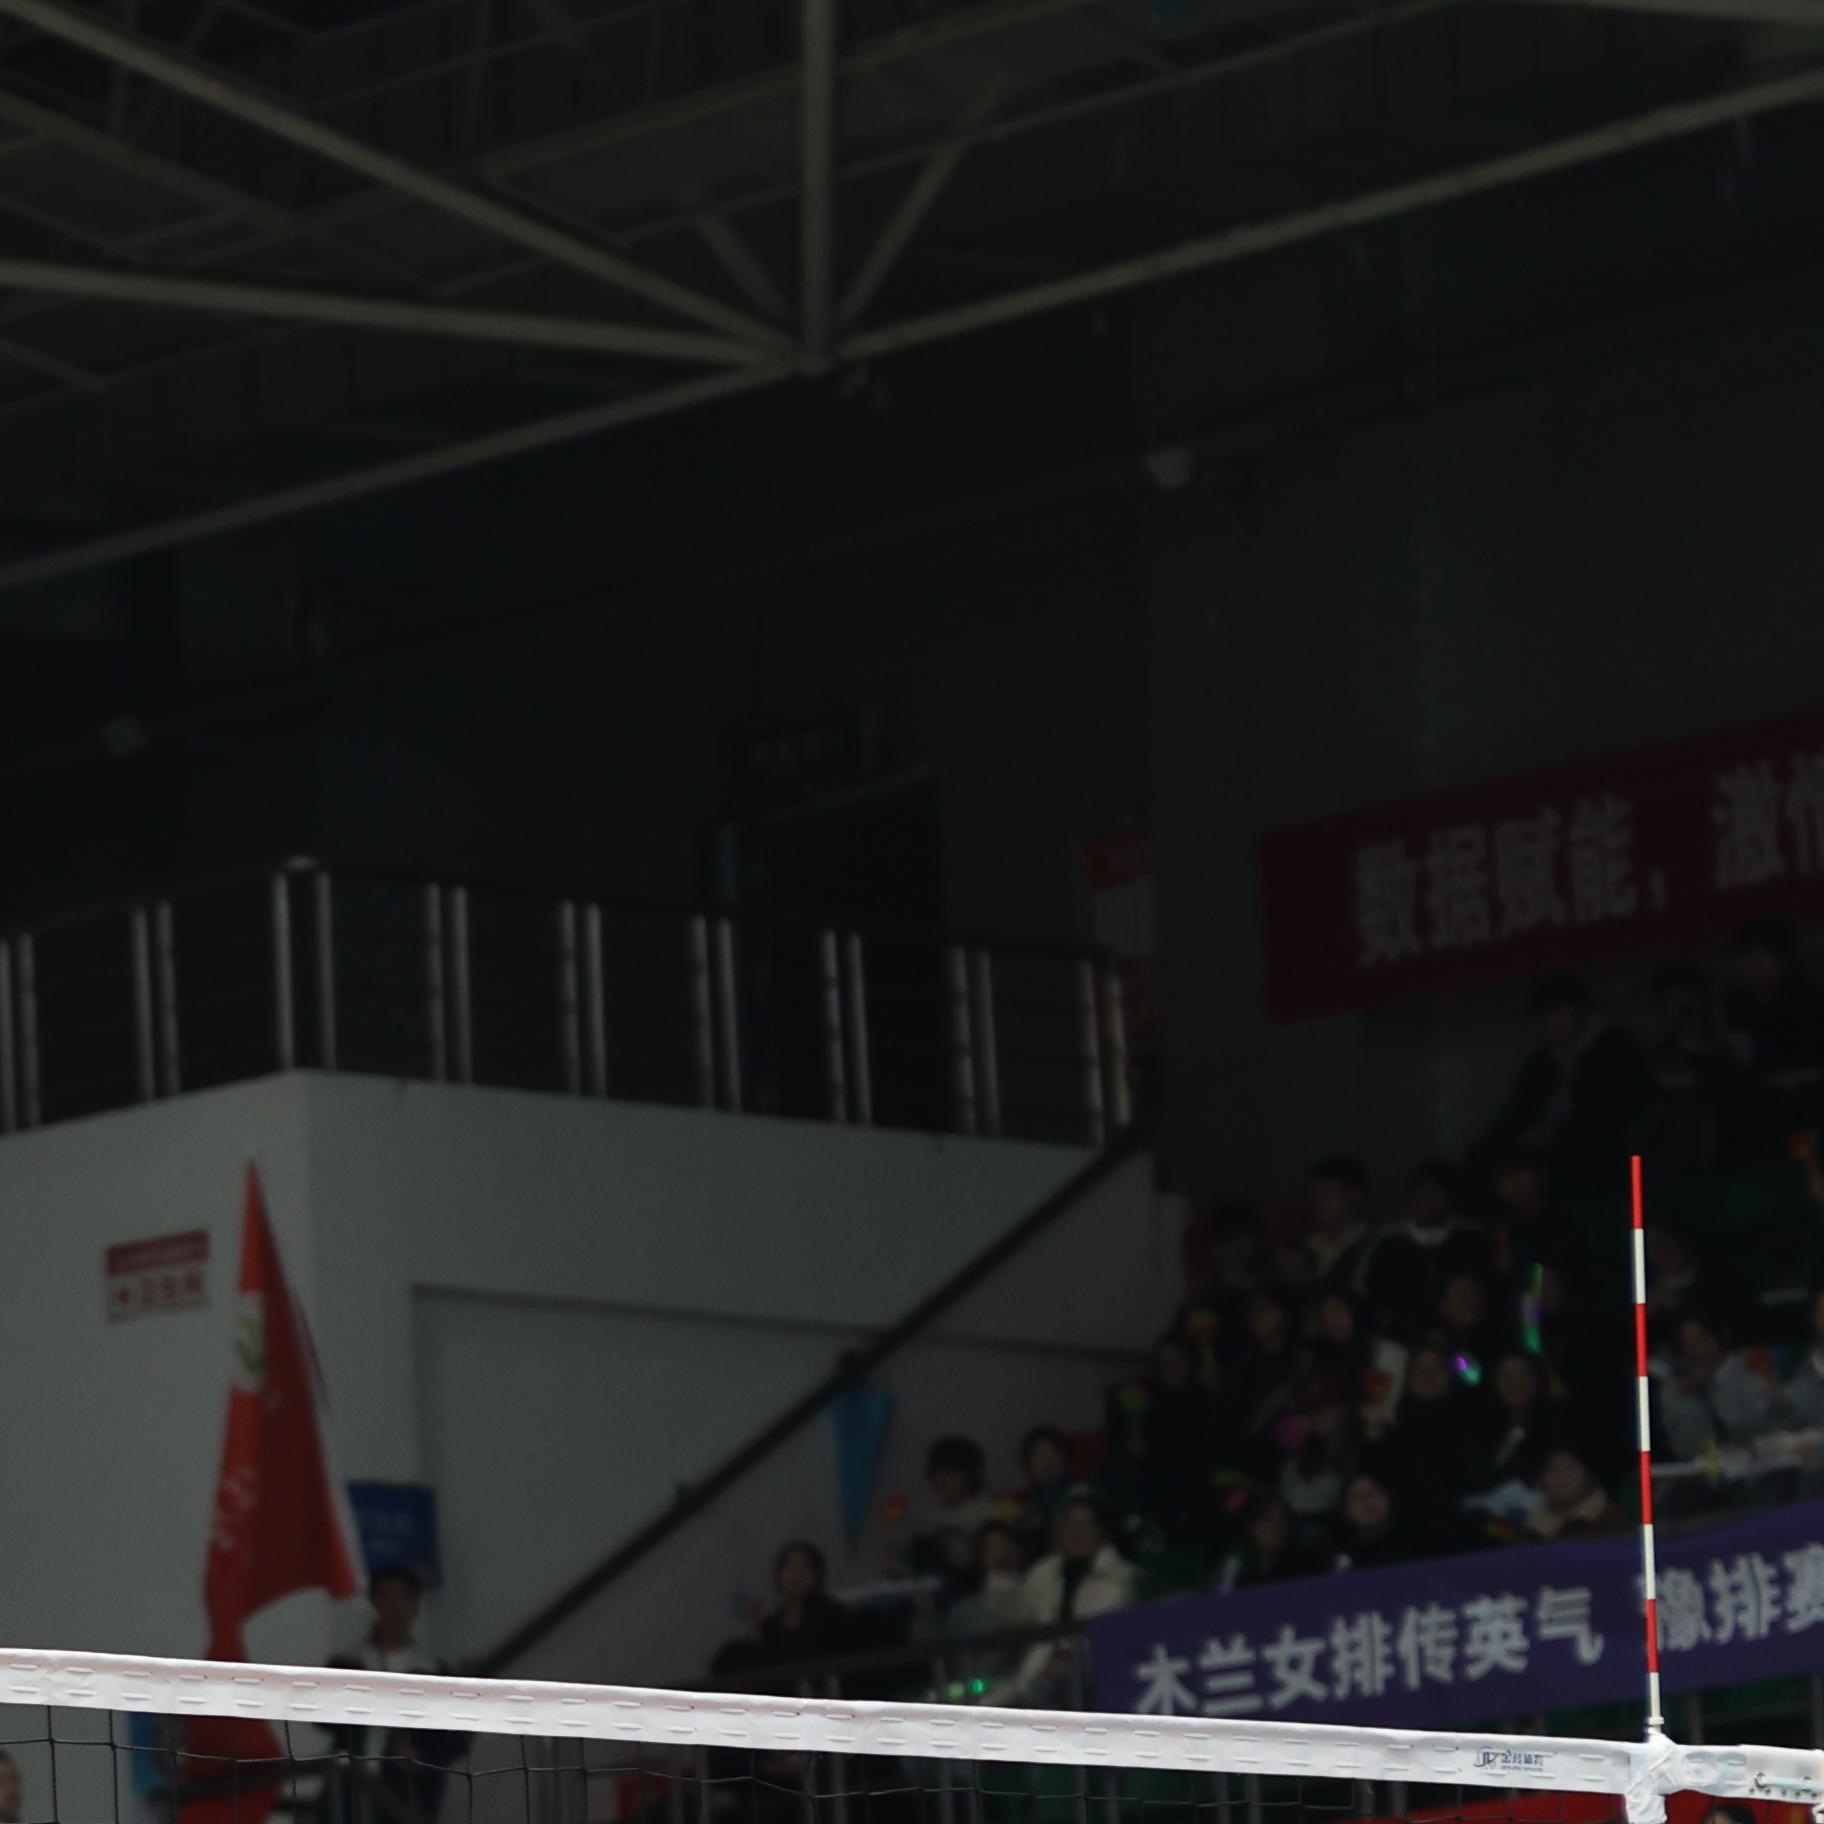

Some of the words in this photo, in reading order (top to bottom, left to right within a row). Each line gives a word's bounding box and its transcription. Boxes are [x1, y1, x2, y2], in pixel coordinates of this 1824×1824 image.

[1134, 1585, 1605, 1718] 木兰女排传英气
